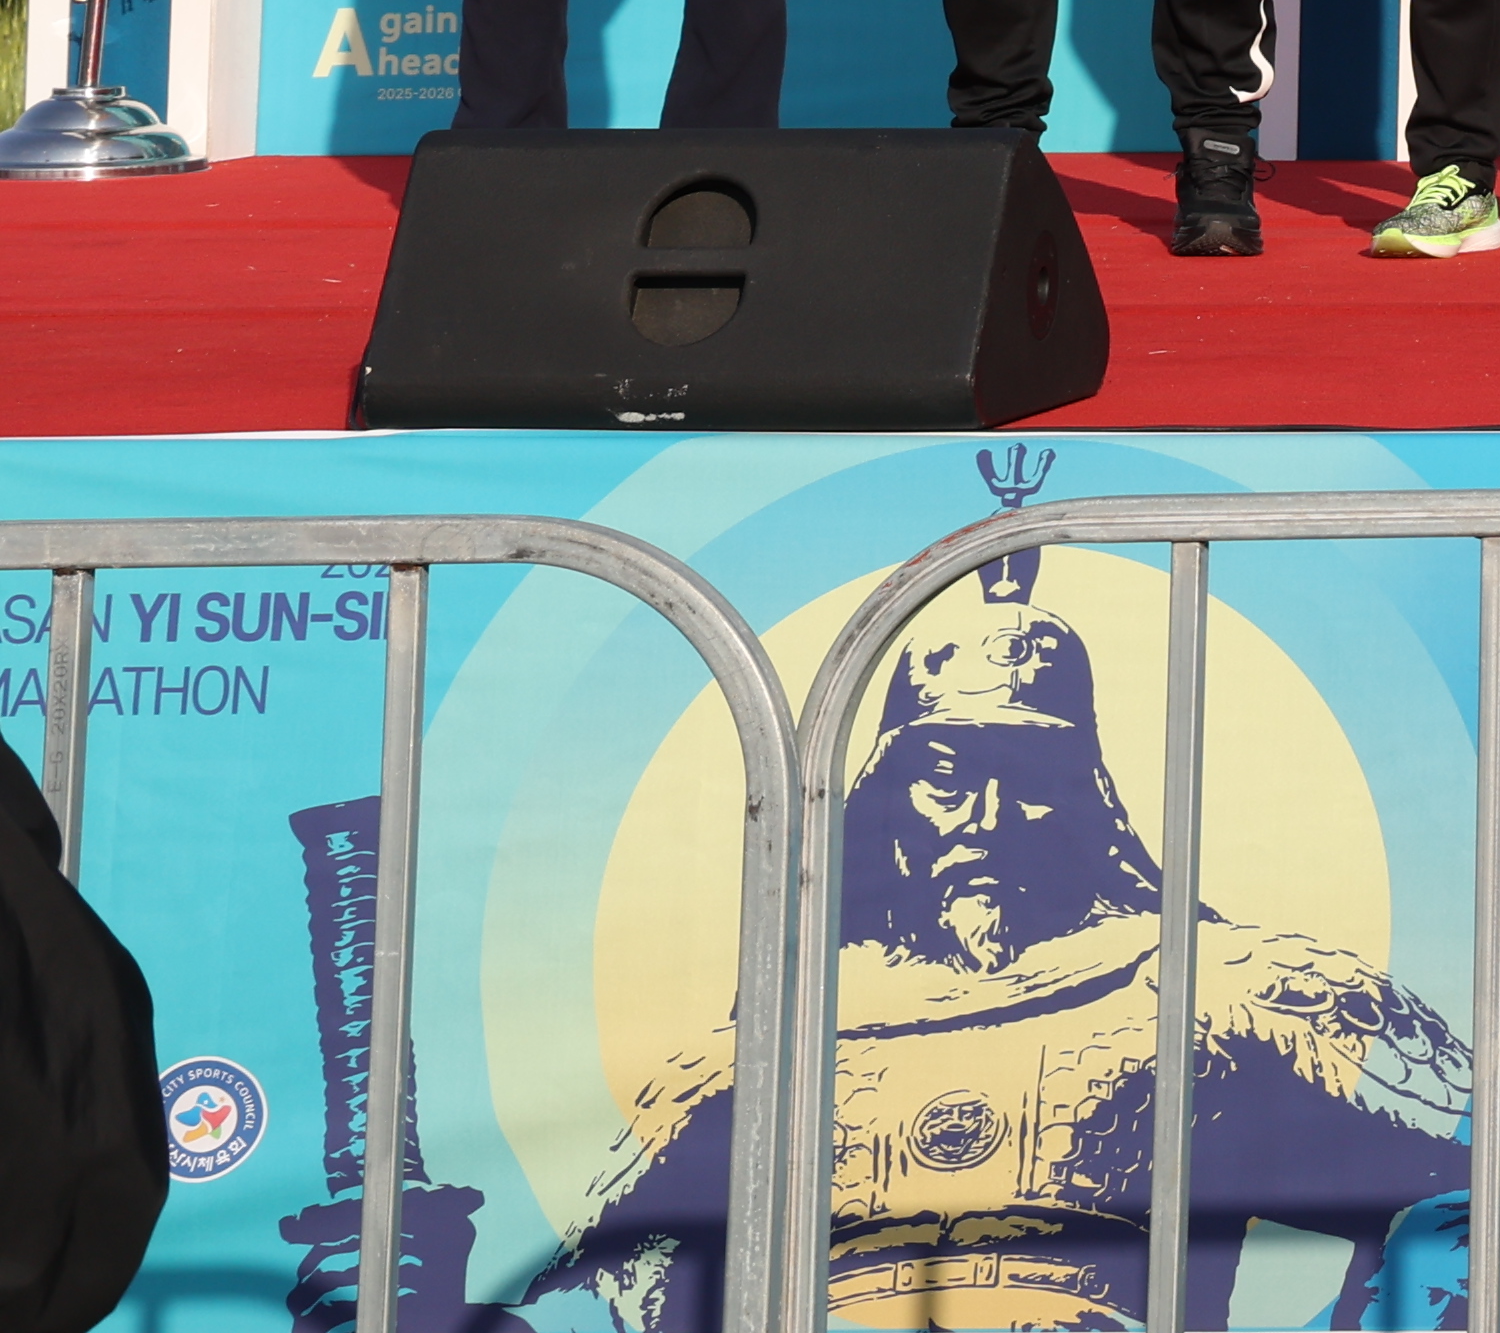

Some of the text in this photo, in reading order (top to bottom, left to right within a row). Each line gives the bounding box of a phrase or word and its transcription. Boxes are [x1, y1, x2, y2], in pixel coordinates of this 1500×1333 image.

[377, 87, 454, 101] 2025-2026
[129, 592, 182, 643] YI
[194, 590, 390, 643] SUN-SI
[162, 1067, 256, 1131] CITY SPORTS COUNCIL
